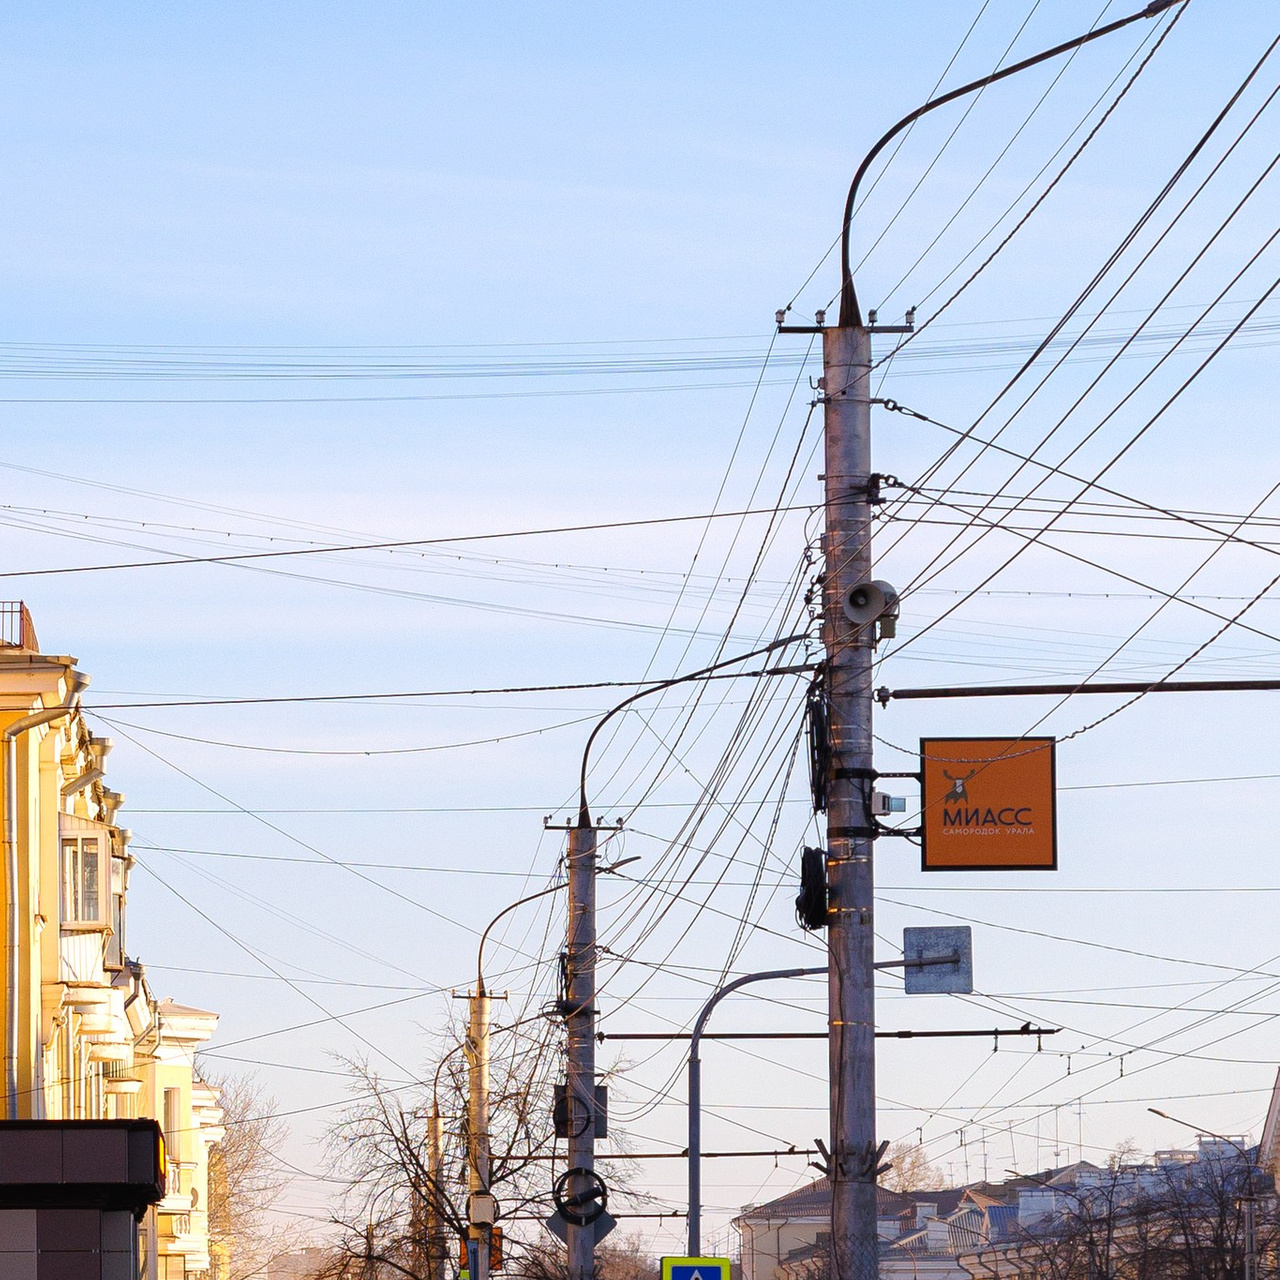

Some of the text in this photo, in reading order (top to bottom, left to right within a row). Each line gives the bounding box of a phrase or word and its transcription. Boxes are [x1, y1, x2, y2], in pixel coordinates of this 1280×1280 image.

[943, 807, 1032, 826] МИАСС
[942, 827, 1035, 835] САМОРОДОК УРАЛА
